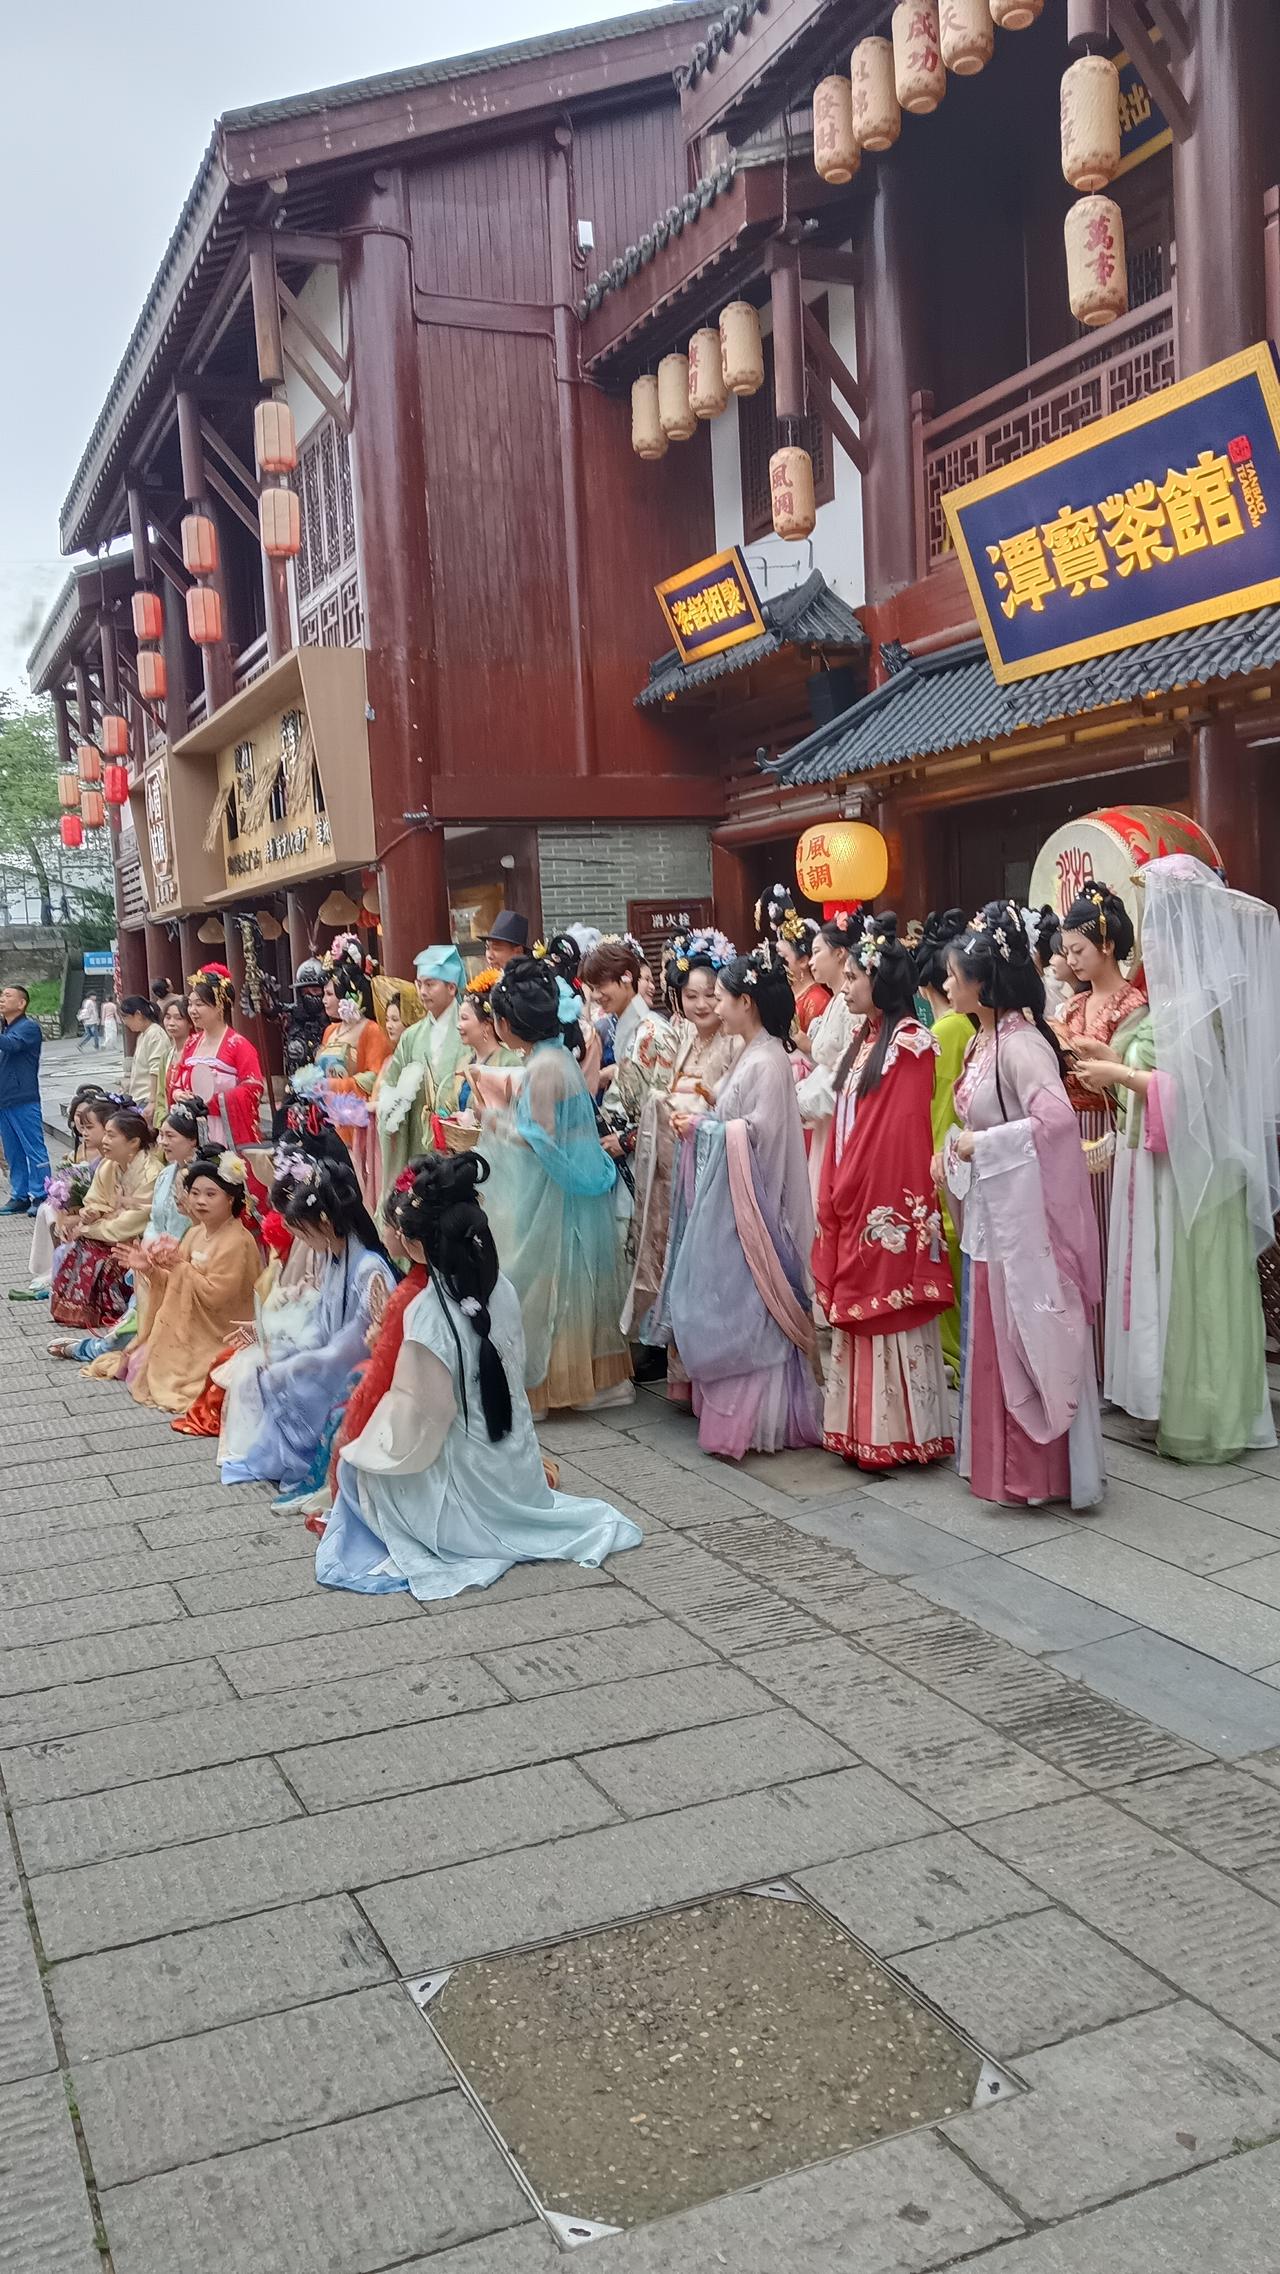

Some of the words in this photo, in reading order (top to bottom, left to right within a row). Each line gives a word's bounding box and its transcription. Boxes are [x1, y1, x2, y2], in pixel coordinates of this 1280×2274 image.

[1236, 464, 1262, 528] TEAROOM
[1245, 460, 1268, 514] TANBAO
[985, 450, 1245, 619] 潭寶茶館
[806, 834, 833, 891] 風調
